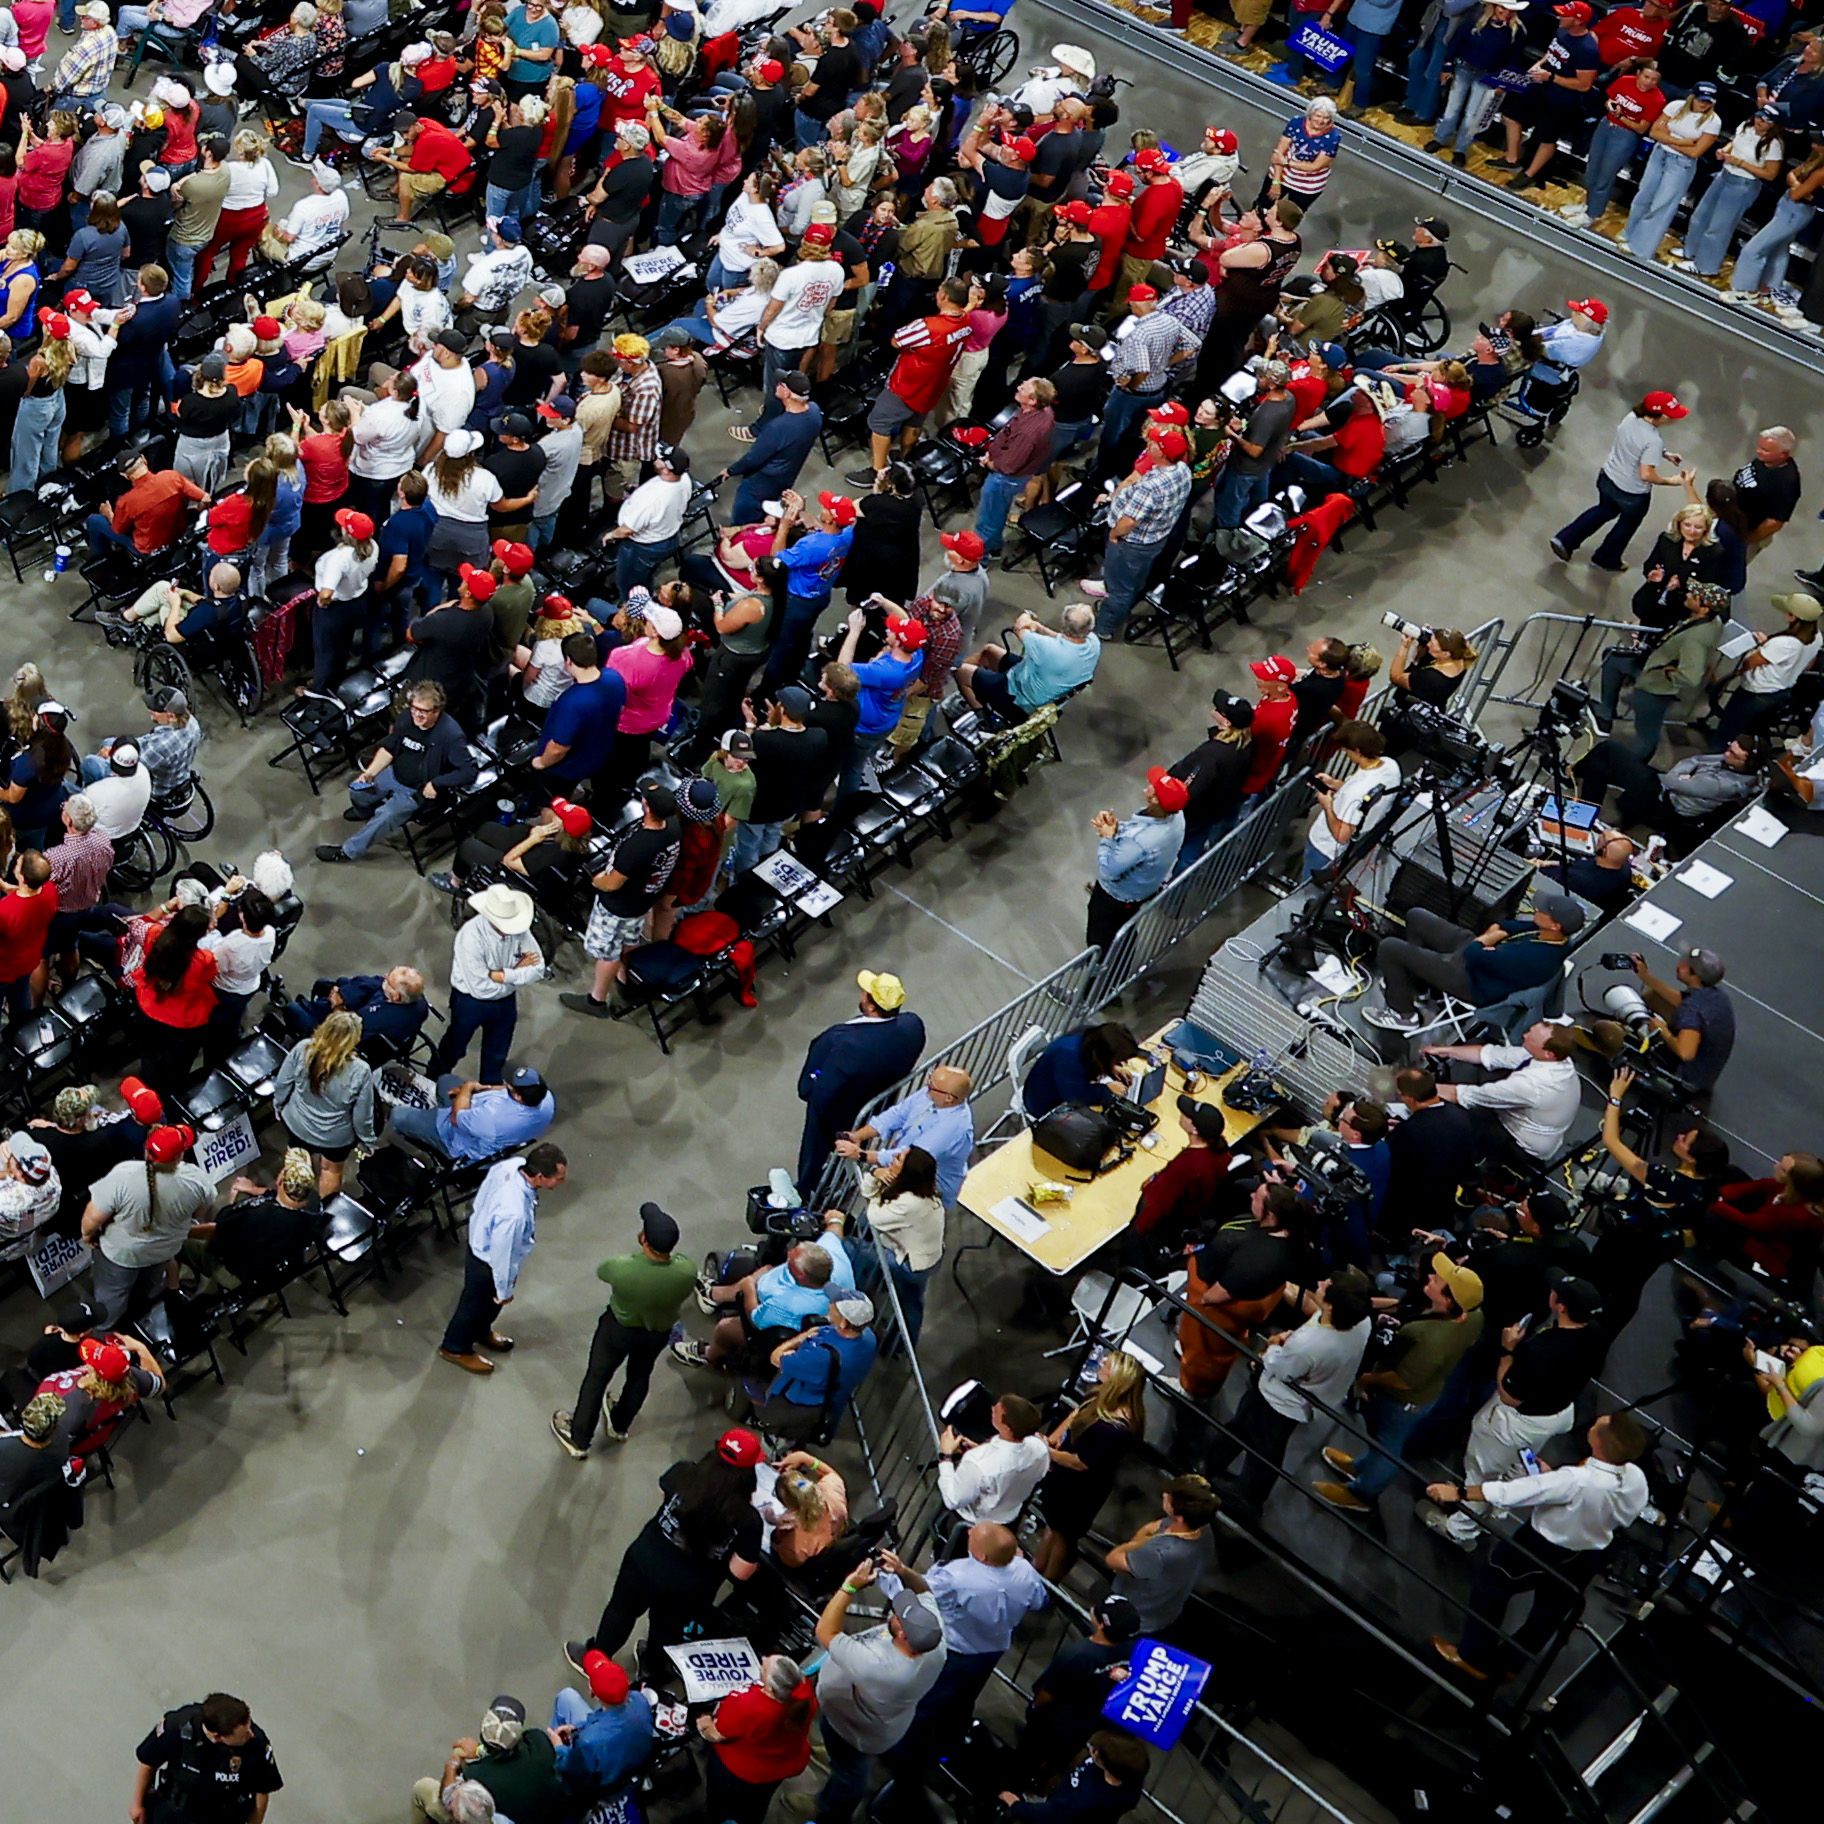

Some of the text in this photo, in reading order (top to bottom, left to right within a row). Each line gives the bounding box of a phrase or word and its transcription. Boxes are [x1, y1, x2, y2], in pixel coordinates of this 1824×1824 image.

[1301, 27, 1347, 57] TRUMP
[1620, 25, 1652, 42] TRUMP
[1301, 36, 1334, 60] VANCE
[1615, 93, 1642, 112] TRUMP
[633, 256, 673, 268] YOU'RE
[635, 261, 680, 274] FIRED!
[202, 1125, 242, 1151] YOU'RE
[204, 1135, 251, 1173] FIRED!
[684, 1653, 750, 1669] FIRED!
[696, 1666, 752, 1681] YOU'RE
[1122, 1647, 1167, 1723] TRUMP
[1139, 1661, 1182, 1724] VANCE
[215, 1771, 239, 1782] POLICE
